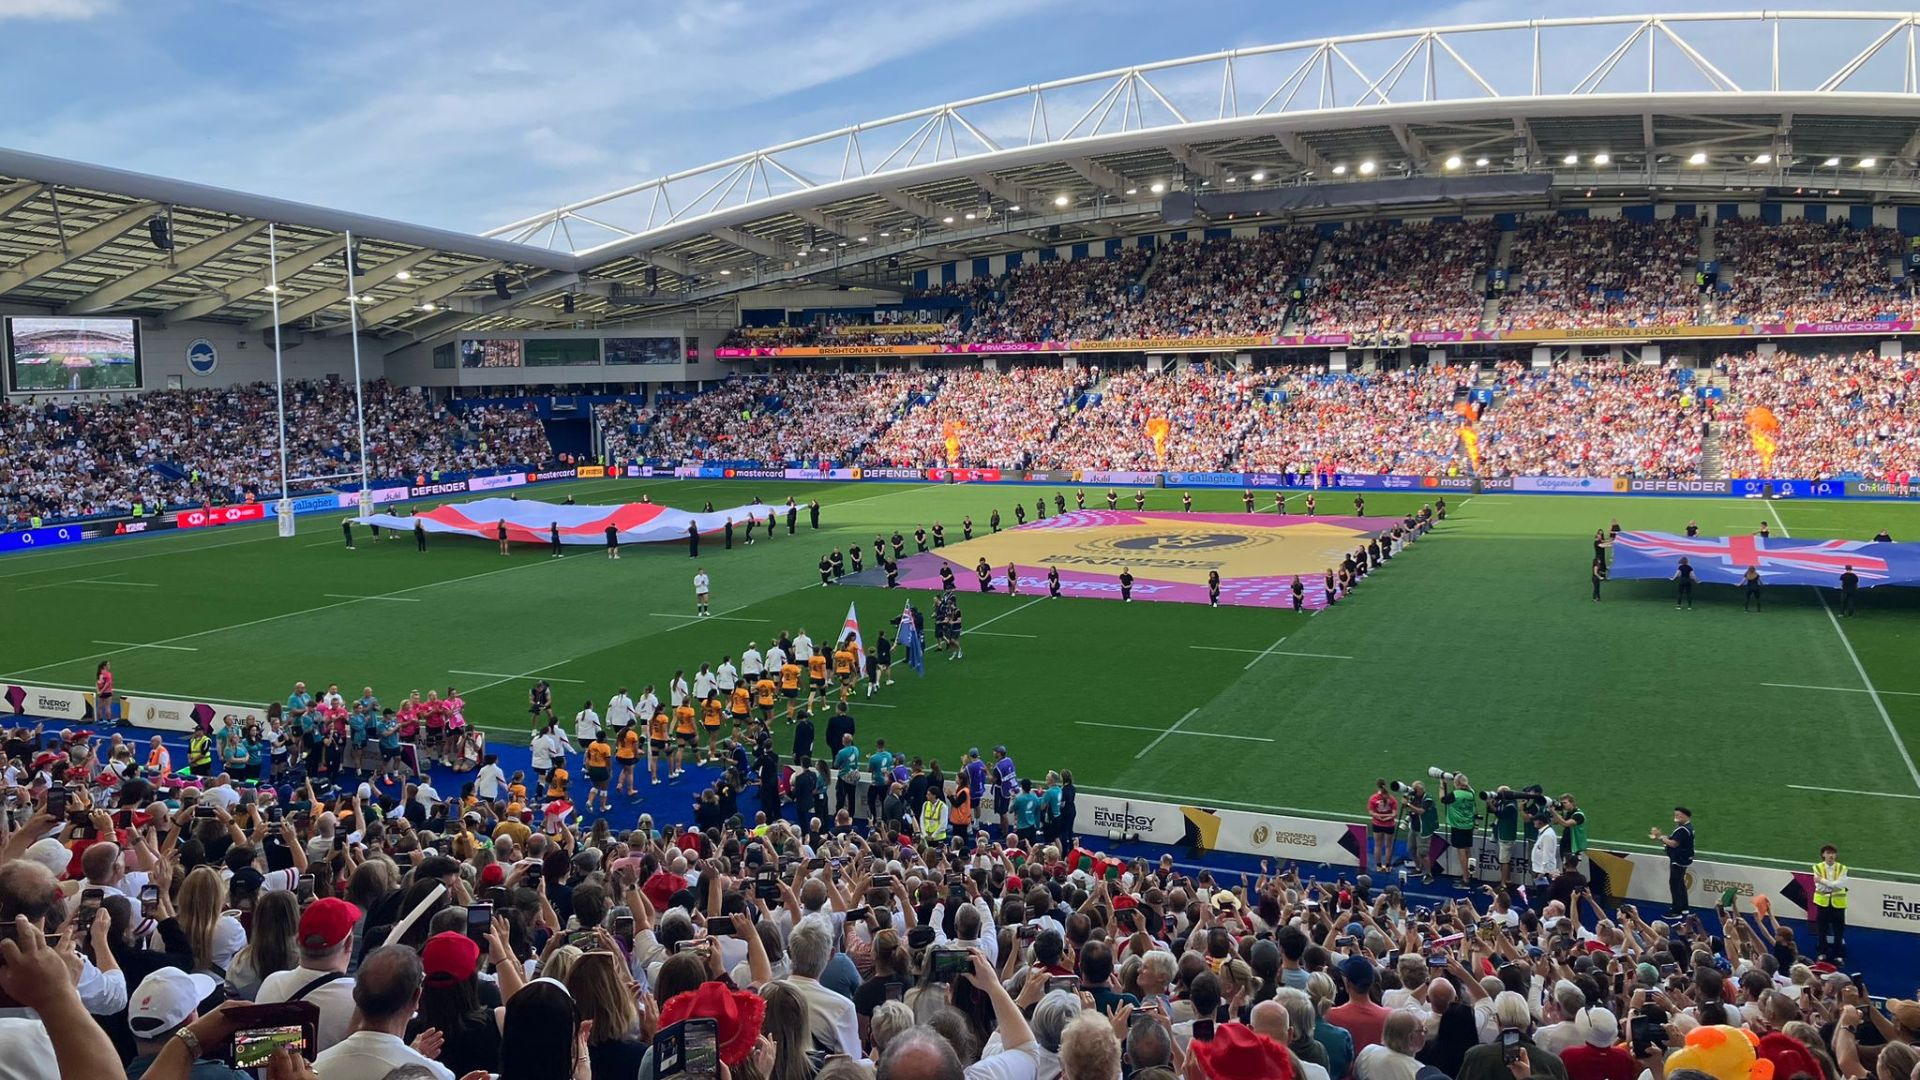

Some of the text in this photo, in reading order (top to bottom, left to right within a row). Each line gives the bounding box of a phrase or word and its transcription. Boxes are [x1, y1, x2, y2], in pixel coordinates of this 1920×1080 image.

[1704, 262, 1711, 270] F
[1495, 270, 1502, 279] E
[1305, 278, 1311, 286] D
[1817, 323, 1890, 331] #RWC2025
[1478, 390, 1486, 402] E
[1705, 389, 1712, 398] F
[537, 469, 576, 479] mastercard
[1187, 474, 1236, 484] Gallagher
[411, 482, 466, 496] DEFENDER
[1632, 481, 1725, 491] DEFENDER
[39, 699, 70, 707] ENERGY
[1094, 812, 1156, 826] ENERGY
[1094, 820, 1123, 829] NEVER
[1276, 831, 1317, 841] WOMEN'S
[1276, 837, 1317, 847] ENG25
[1703, 879, 1754, 889] WOMEN'S
[1703, 885, 1754, 896] EN25
